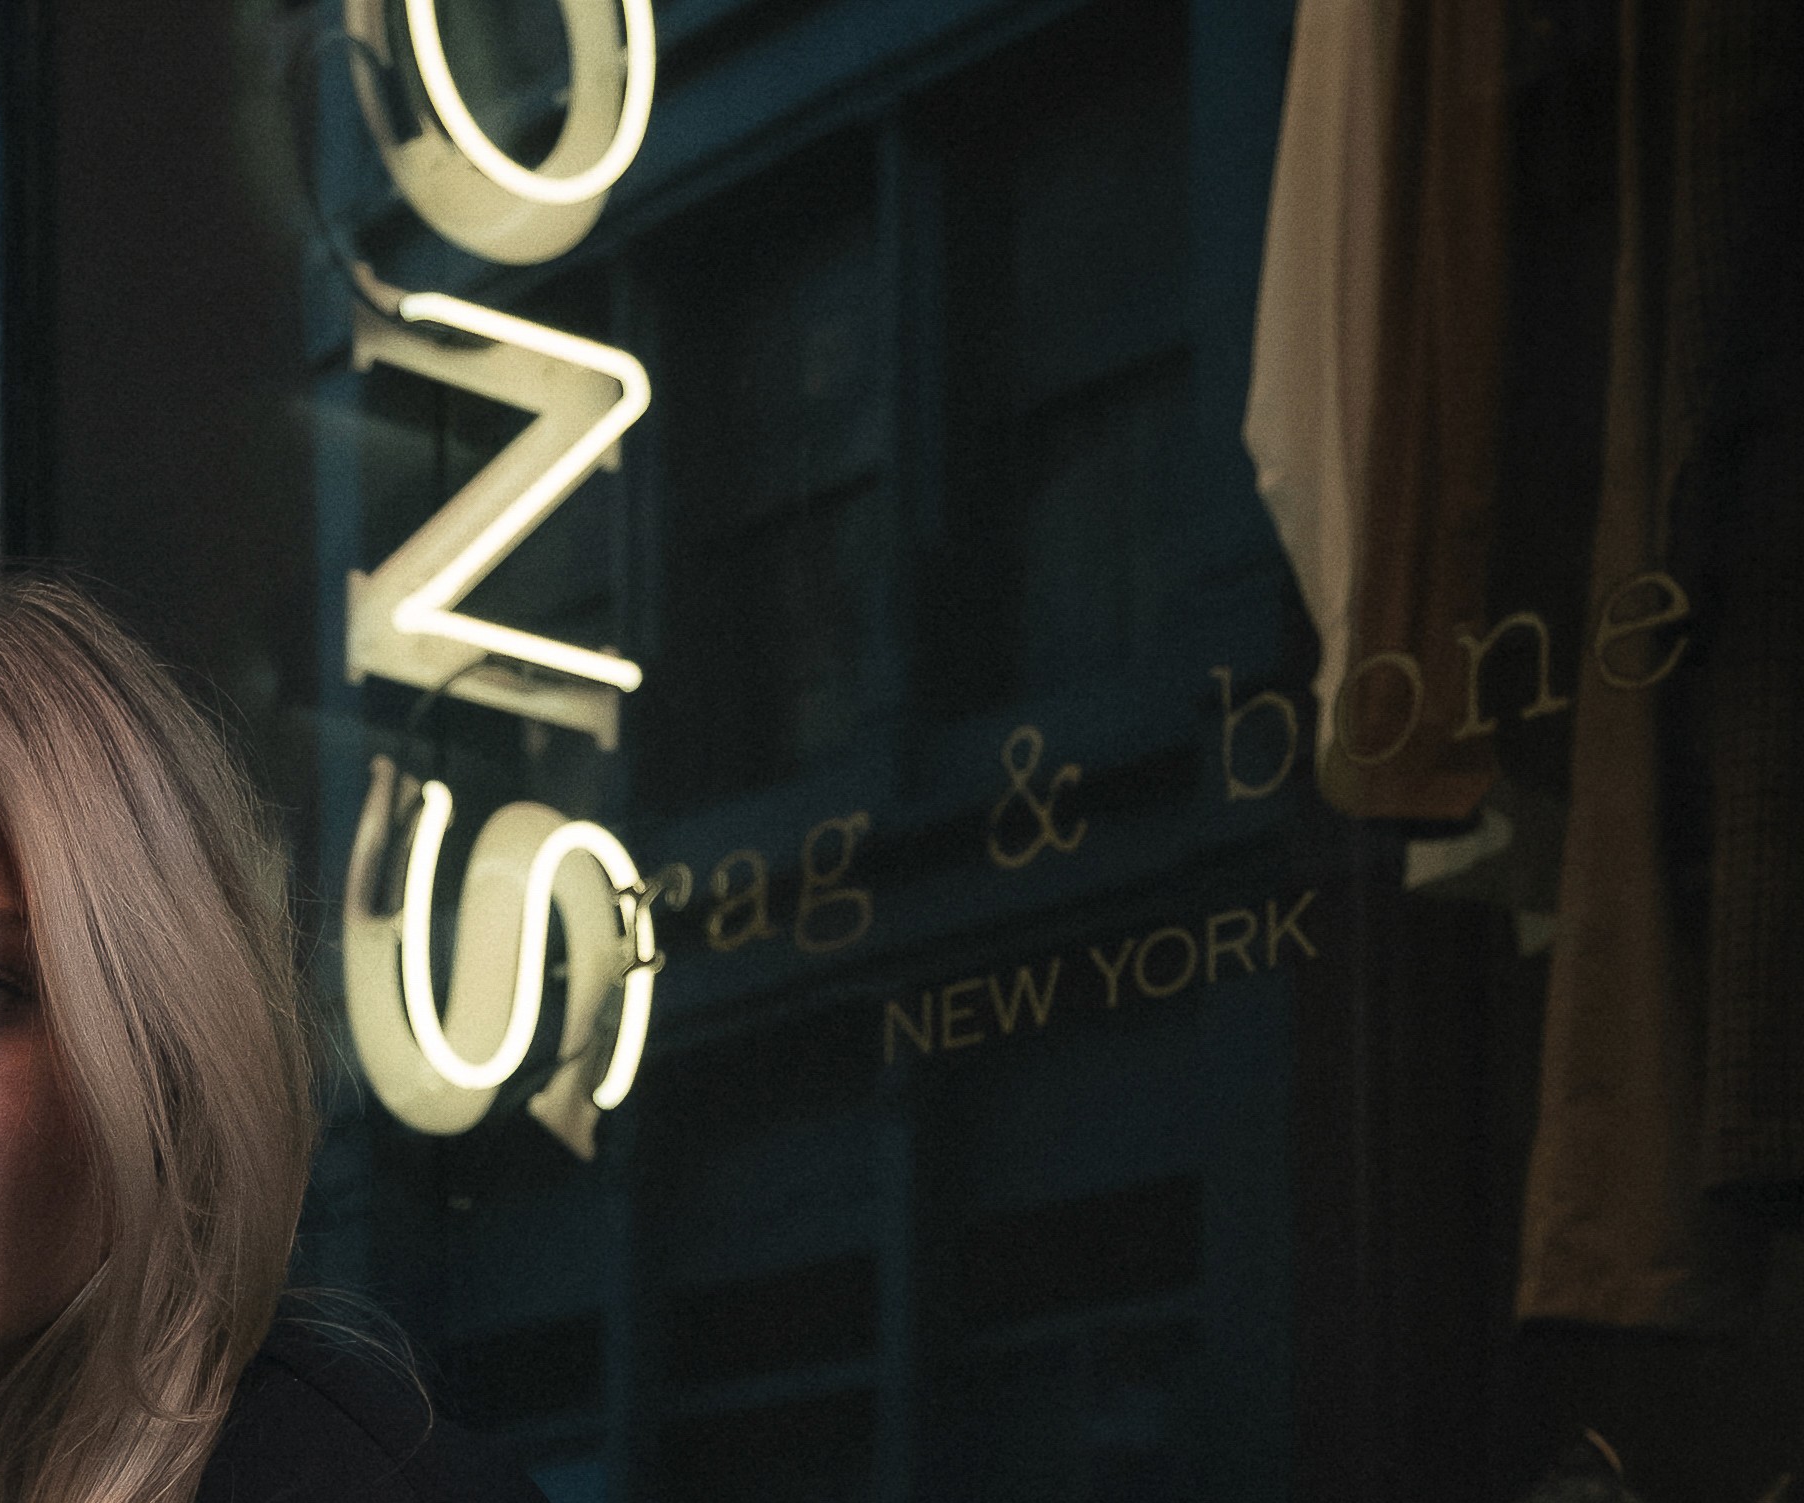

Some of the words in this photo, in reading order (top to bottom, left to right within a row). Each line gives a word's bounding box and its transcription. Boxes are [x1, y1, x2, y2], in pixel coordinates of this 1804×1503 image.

[620, 810, 874, 972] rag
[989, 725, 1088, 868] &
[1209, 571, 1690, 802] bone
[882, 956, 1062, 1064] NEW
[1088, 889, 1320, 1009] YORK
